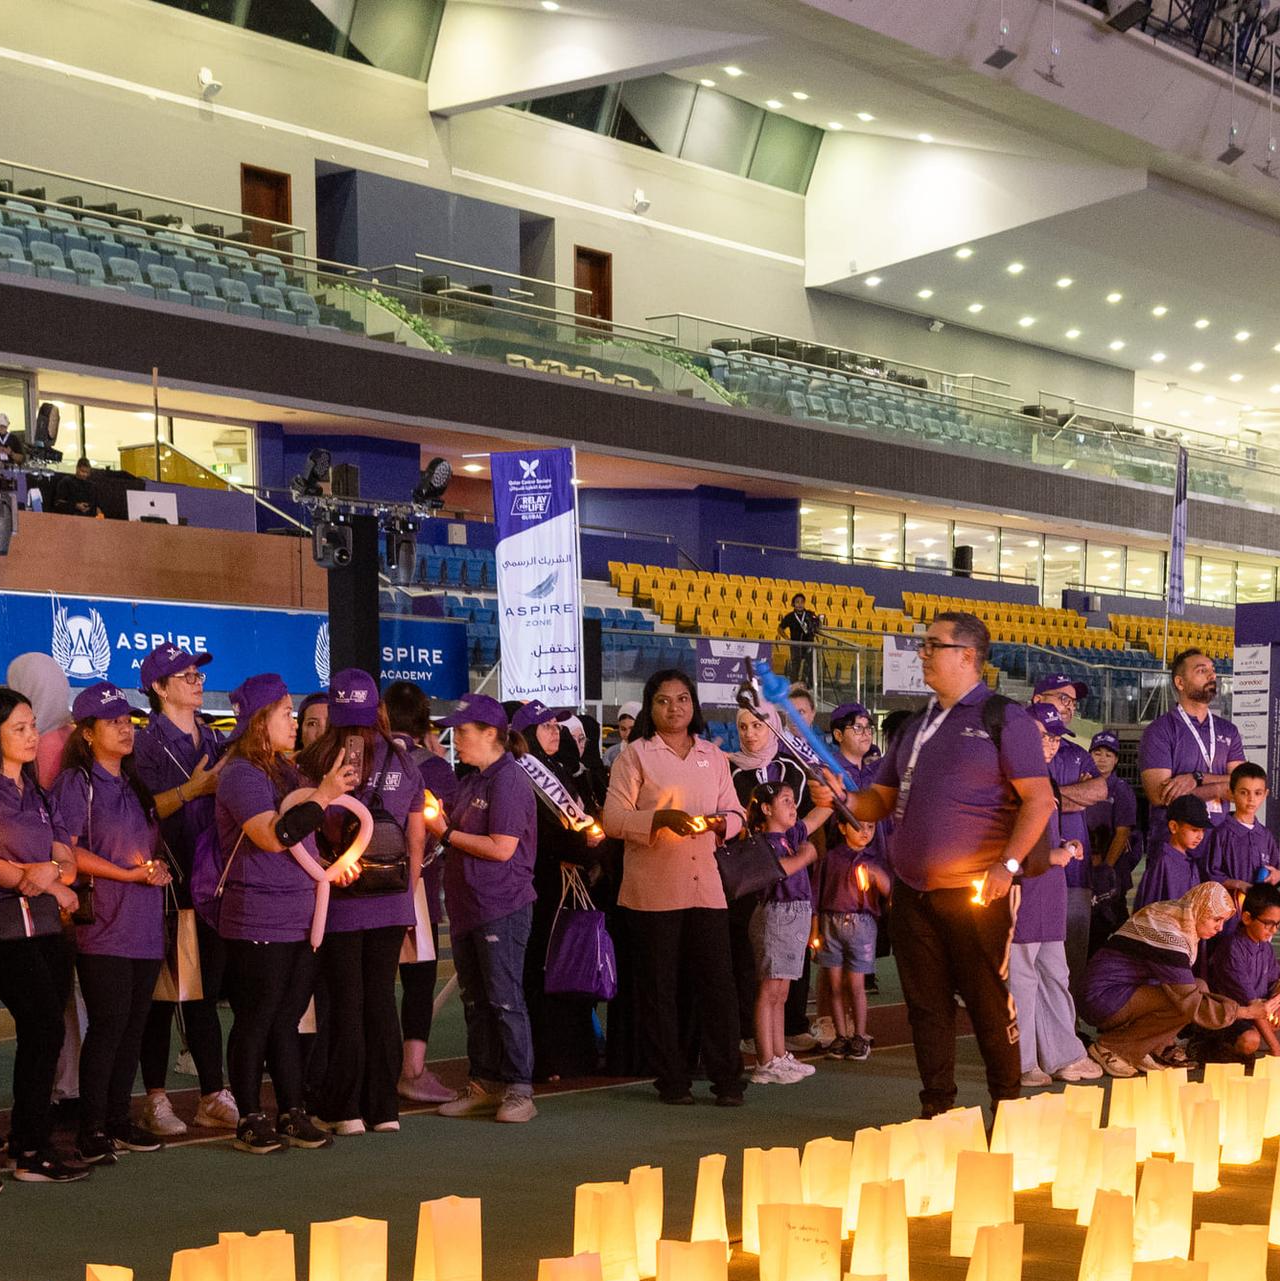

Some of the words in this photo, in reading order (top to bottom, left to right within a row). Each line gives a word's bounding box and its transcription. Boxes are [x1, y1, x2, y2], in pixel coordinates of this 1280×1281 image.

[522, 495, 547, 505] RELAY
[527, 503, 546, 512] LIFE
[502, 556, 536, 570] الرسمي
[505, 603, 574, 617] ASPIRE
[526, 619, 552, 627] ZONE
[116, 630, 208, 653] ASPIRE
[382, 645, 443, 666] SPIRE
[531, 643, 577, 658] نحتفل.
[380, 669, 433, 681] ACADEMY
[534, 664, 577, 678] نتذكر.
